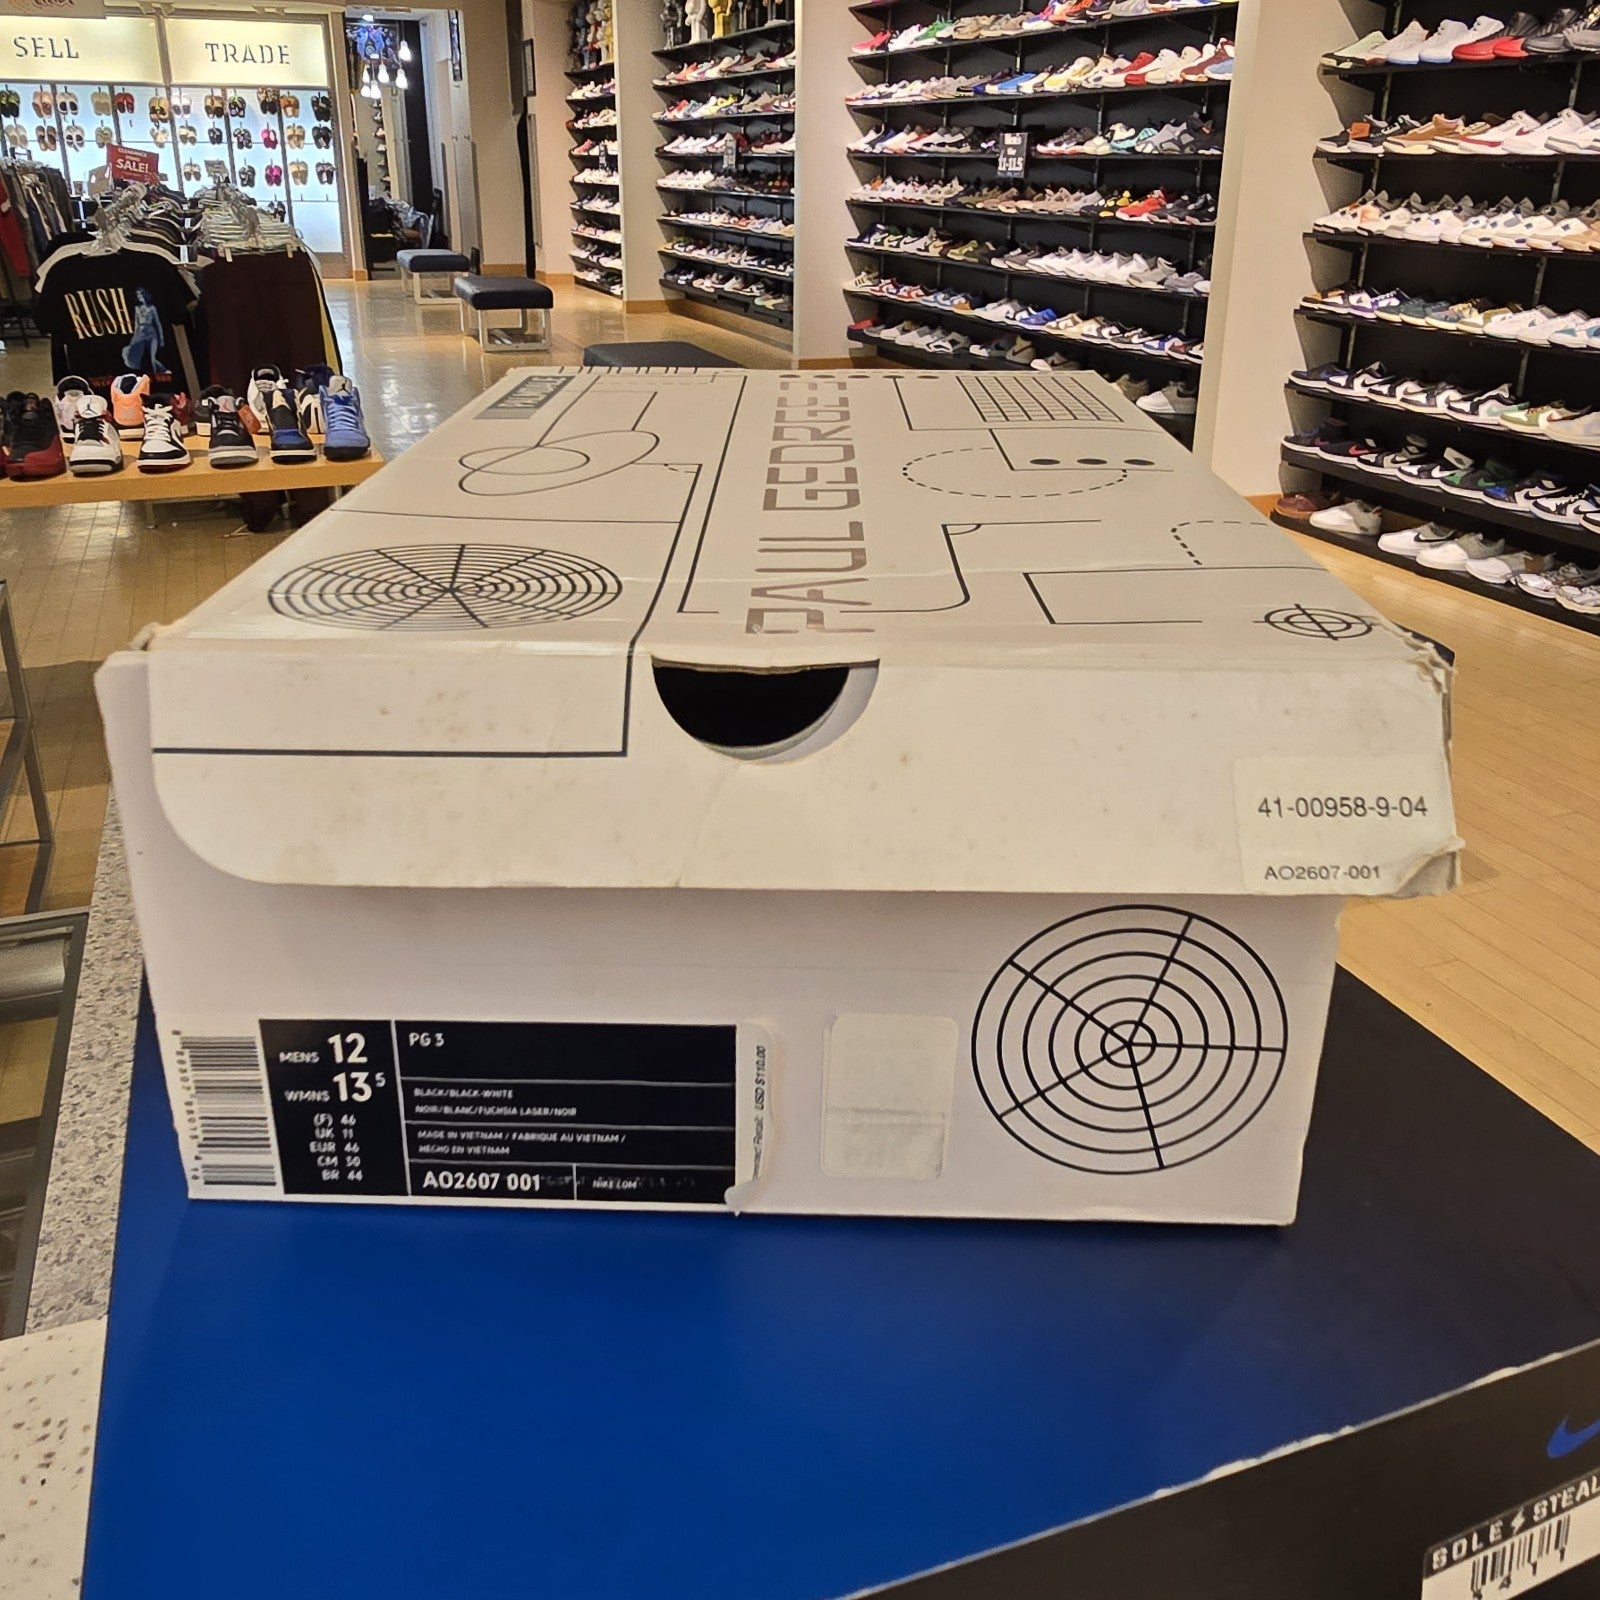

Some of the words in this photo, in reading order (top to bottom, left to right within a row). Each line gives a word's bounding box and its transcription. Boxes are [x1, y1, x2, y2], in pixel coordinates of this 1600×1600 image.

[13, 36, 80, 59] SELL
[205, 43, 291, 65] TRADE
[116, 158, 149, 173] SALE!
[64, 287, 134, 340] RUSH
[745, 521, 875, 634] PAUL
[1257, 795, 1428, 818] 41-00958-9-04
[408, 1032, 432, 1047] PG
[434, 1033, 445, 1047] 3
[279, 1051, 320, 1063] MENS
[327, 1032, 368, 1064] 12
[284, 1089, 330, 1102] WMNS
[754, 1087, 765, 1111] USD
[340, 1114, 357, 1126] 46
[315, 1128, 335, 1139] UK
[342, 1128, 354, 1139] 11
[417, 1130, 445, 1140] MADE
[447, 1130, 458, 1139] IN
[461, 1130, 504, 1140] VIETNAM
[560, 1133, 574, 1142] AU
[576, 1133, 619, 1143] VIETNAM
[309, 1141, 336, 1153] EUR
[344, 1142, 360, 1153] 46
[466, 1145, 510, 1155] VIETNAM
[317, 1155, 338, 1167] CM
[322, 1169, 340, 1181] BR
[507, 1172, 540, 1191] 001
[1432, 1519, 1504, 1571] SOLE
